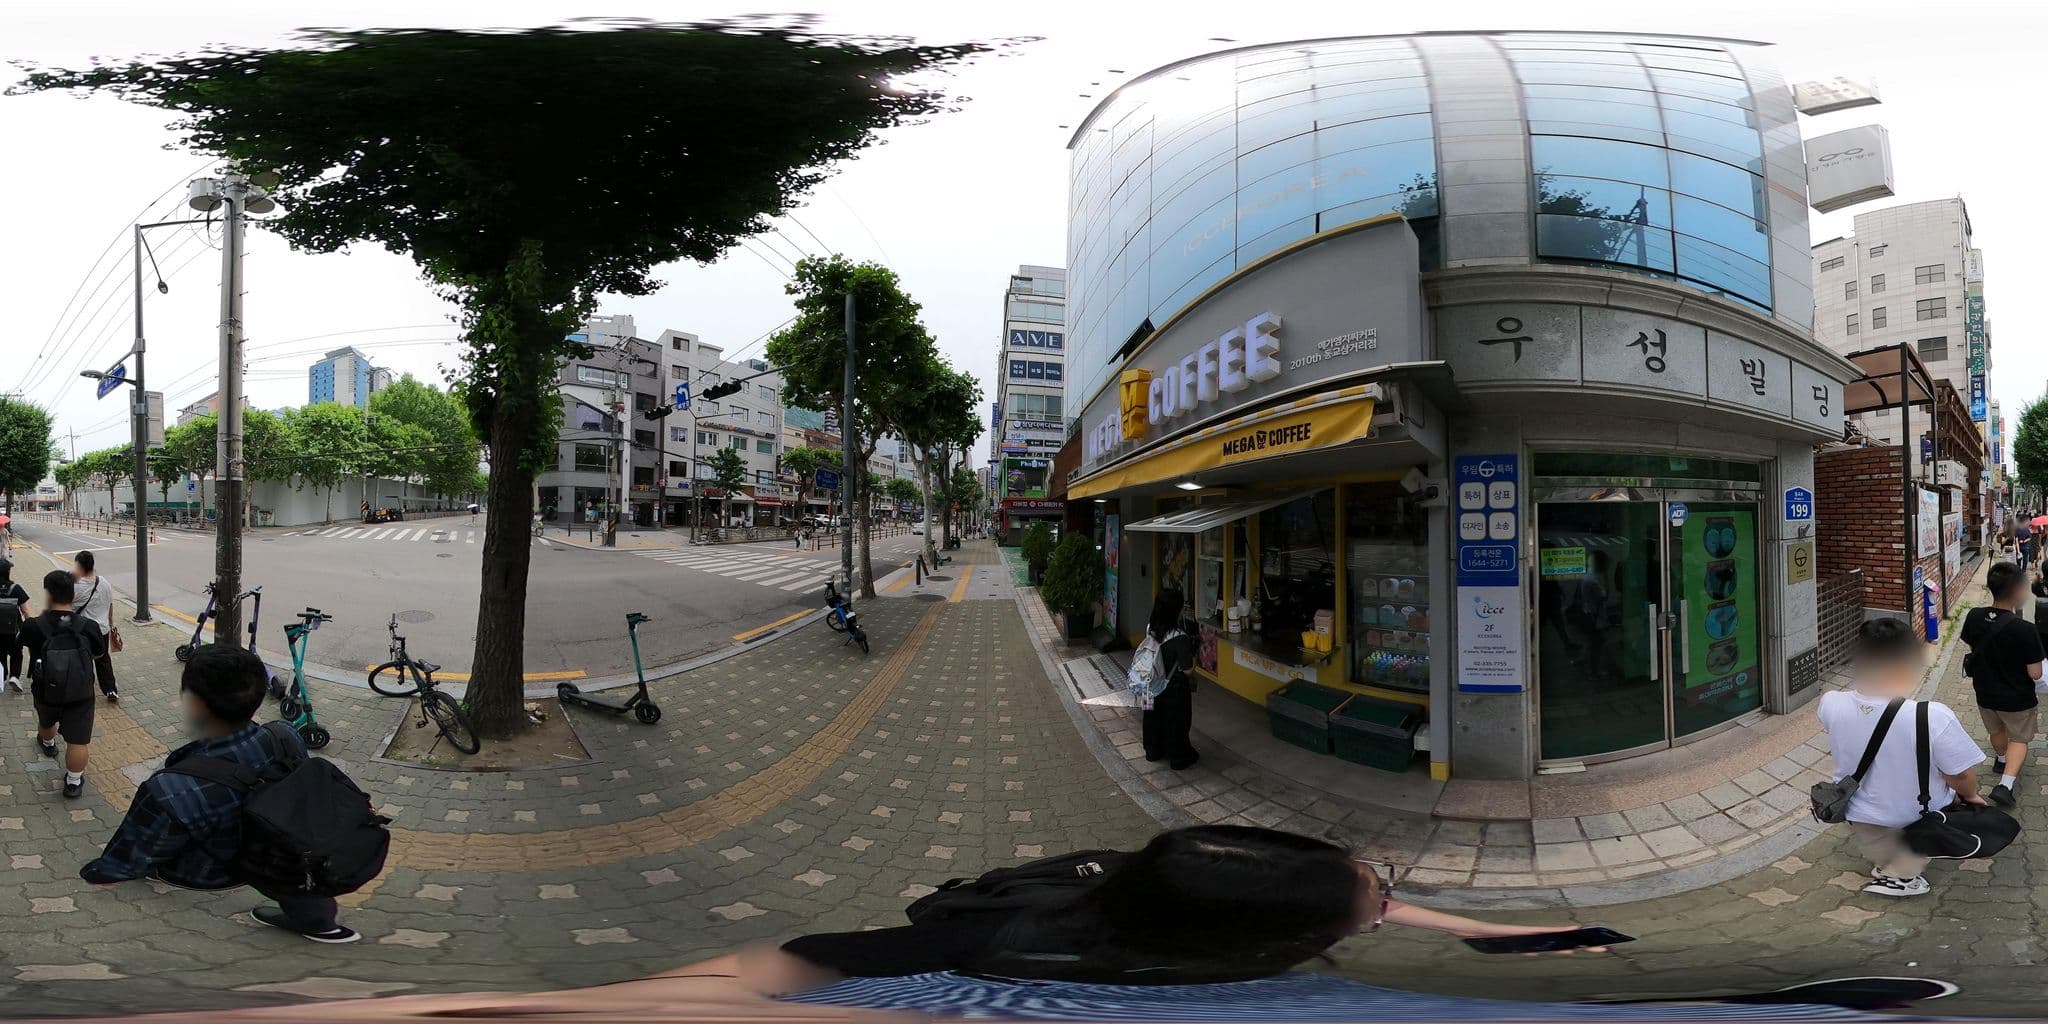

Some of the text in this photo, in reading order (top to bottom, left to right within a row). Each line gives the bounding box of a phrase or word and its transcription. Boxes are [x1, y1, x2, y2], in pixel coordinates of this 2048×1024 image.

[1012, 332, 1060, 347] AVE
[1290, 353, 1321, 370] 2010th
[1478, 316, 1829, 418] 우성빌딩
[1149, 312, 1281, 425] COFFEE
[1223, 422, 1312, 456] MEGA COFFEE
[1463, 490, 1481, 501] 특허
[1493, 490, 1511, 501] 상표
[1671, 509, 1686, 519] ADT
[1791, 503, 1808, 518] 199
[1462, 522, 1484, 531] 디자인
[1495, 521, 1510, 531] 소송
[1468, 559, 1508, 567] 1644-5271
[1484, 624, 1495, 632] 2F
[1262, 660, 1276, 671] UP
